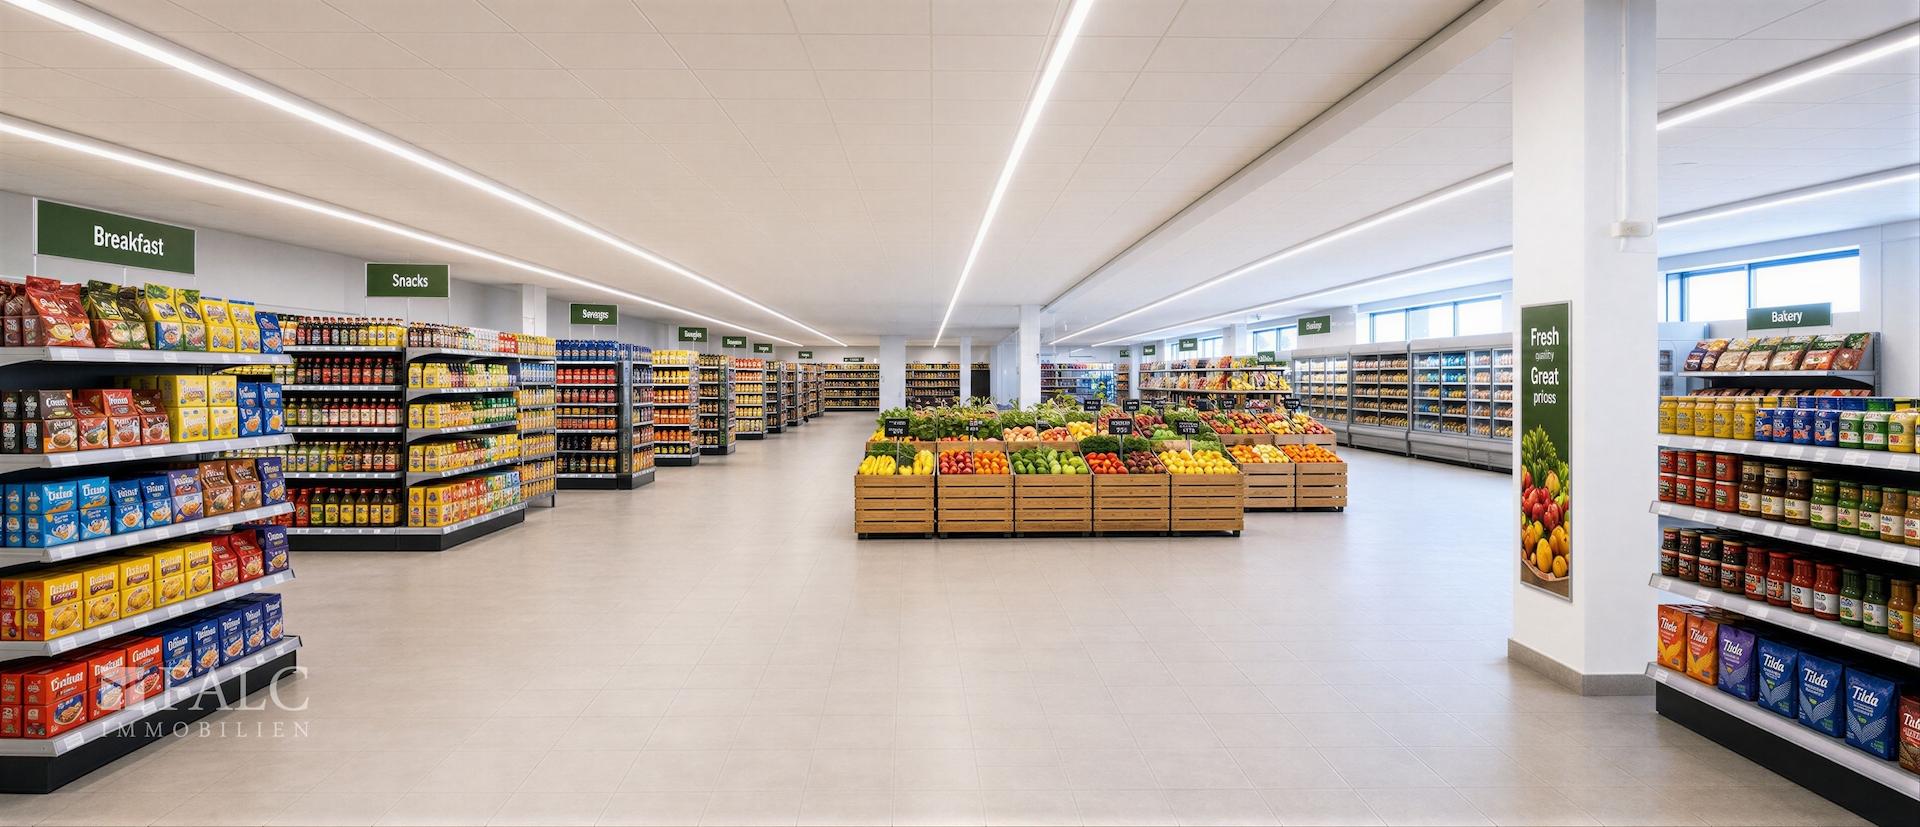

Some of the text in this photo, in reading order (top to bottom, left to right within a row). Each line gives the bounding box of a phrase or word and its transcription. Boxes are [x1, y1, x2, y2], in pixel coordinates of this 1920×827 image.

[94, 225, 164, 256] Breakfast
[392, 273, 429, 288] Snacks
[1771, 310, 1803, 324] Bakery
[1530, 326, 1560, 346] Fresh
[1530, 366, 1560, 385] Great
[1763, 653, 1785, 673] Tilda
[1804, 668, 1829, 688] Tilda
[1852, 685, 1879, 707] Tilda
